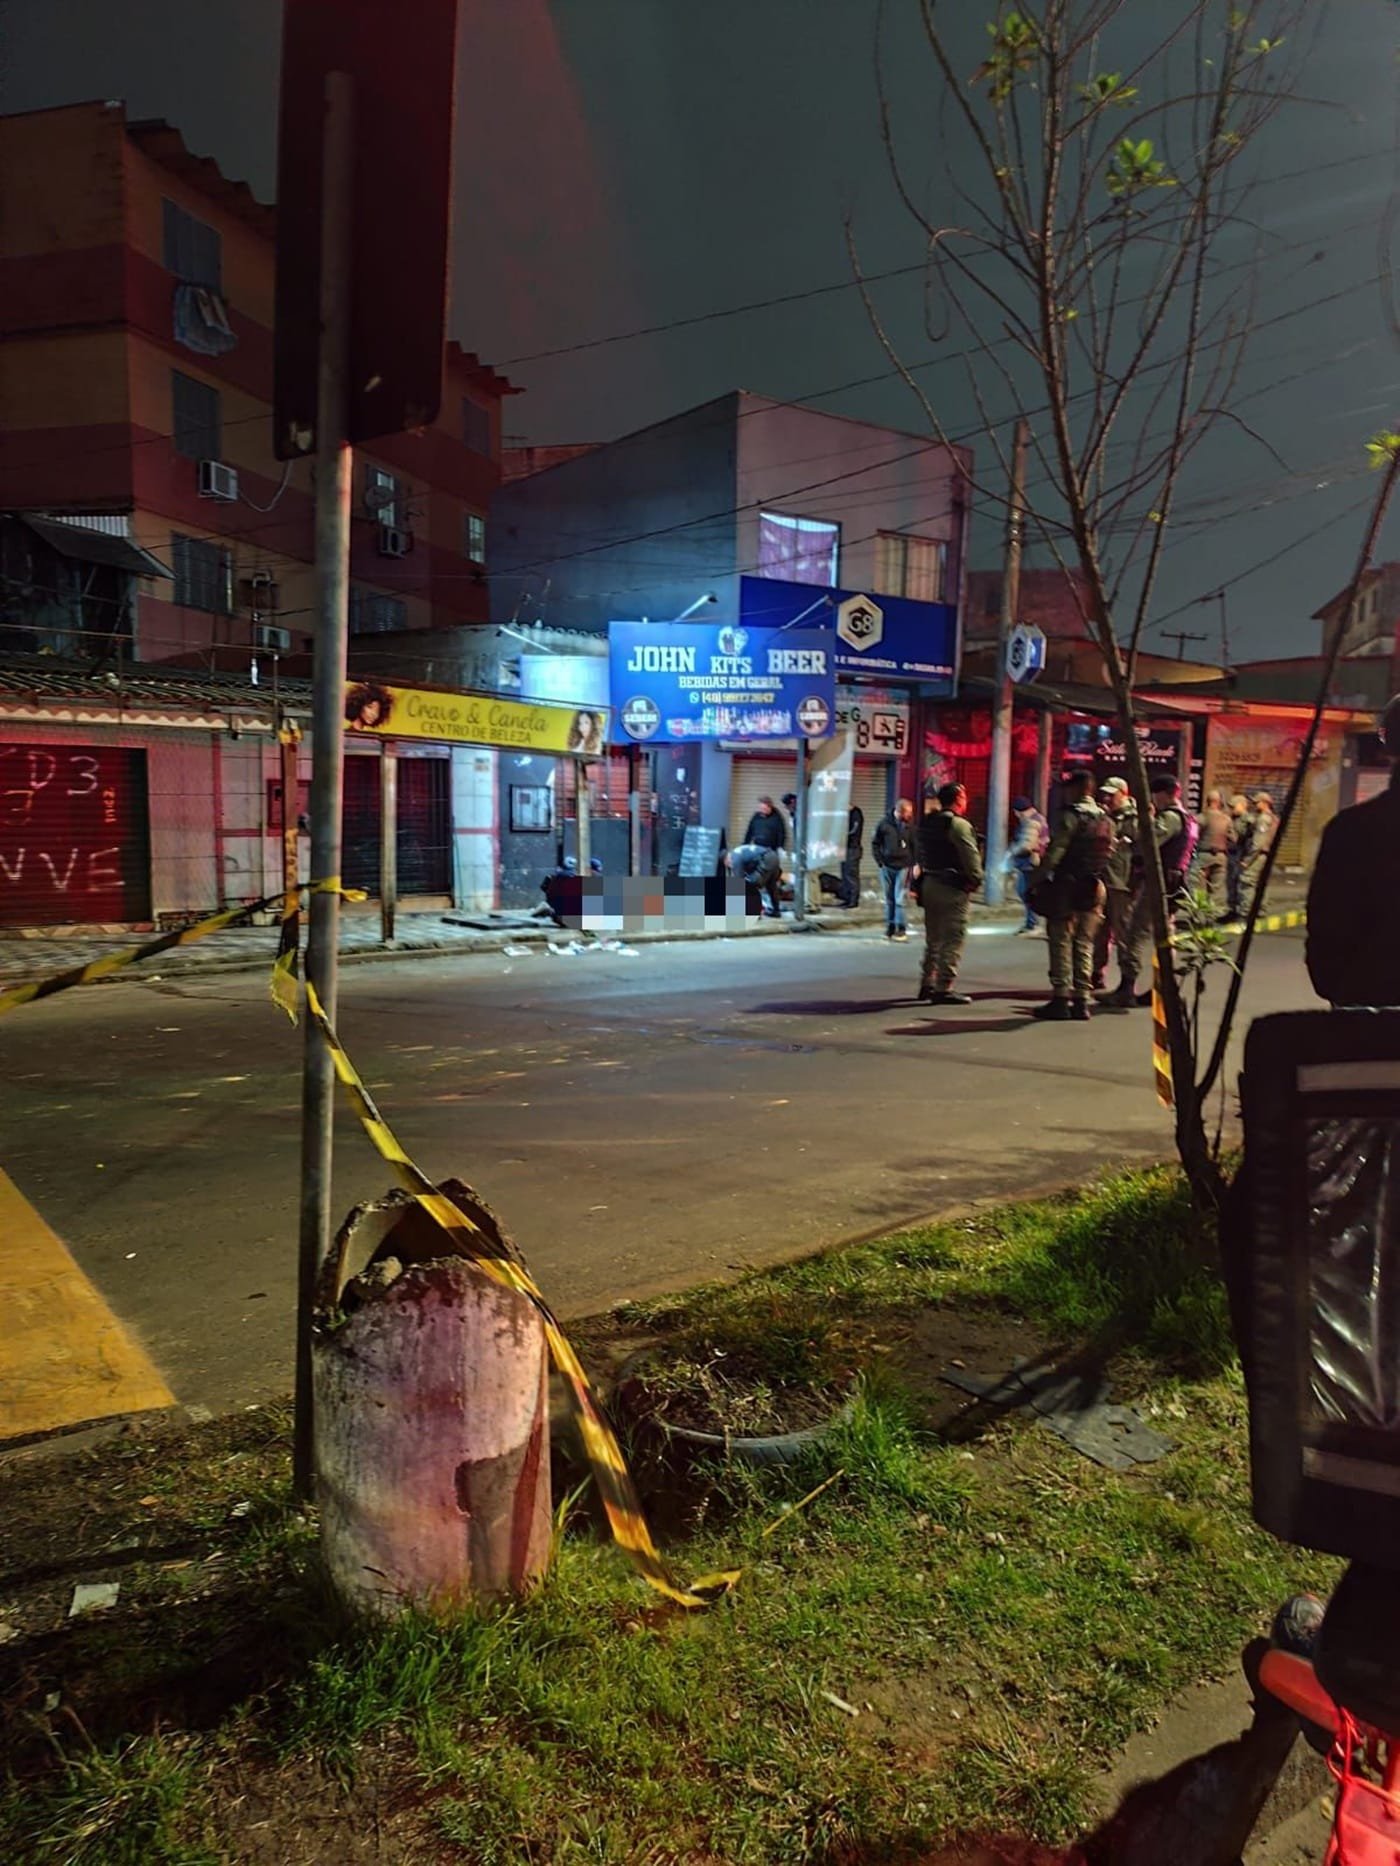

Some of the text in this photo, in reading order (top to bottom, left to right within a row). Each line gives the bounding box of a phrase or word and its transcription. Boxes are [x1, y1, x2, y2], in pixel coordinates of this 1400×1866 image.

[627, 645, 827, 675] JOHN KITS BEER
[678, 676, 728, 688] BEBIDAS
[729, 676, 746, 688] EM
[405, 694, 548, 733] Cravo & Canela
[420, 720, 532, 744] CENTRO DE BELEZA
